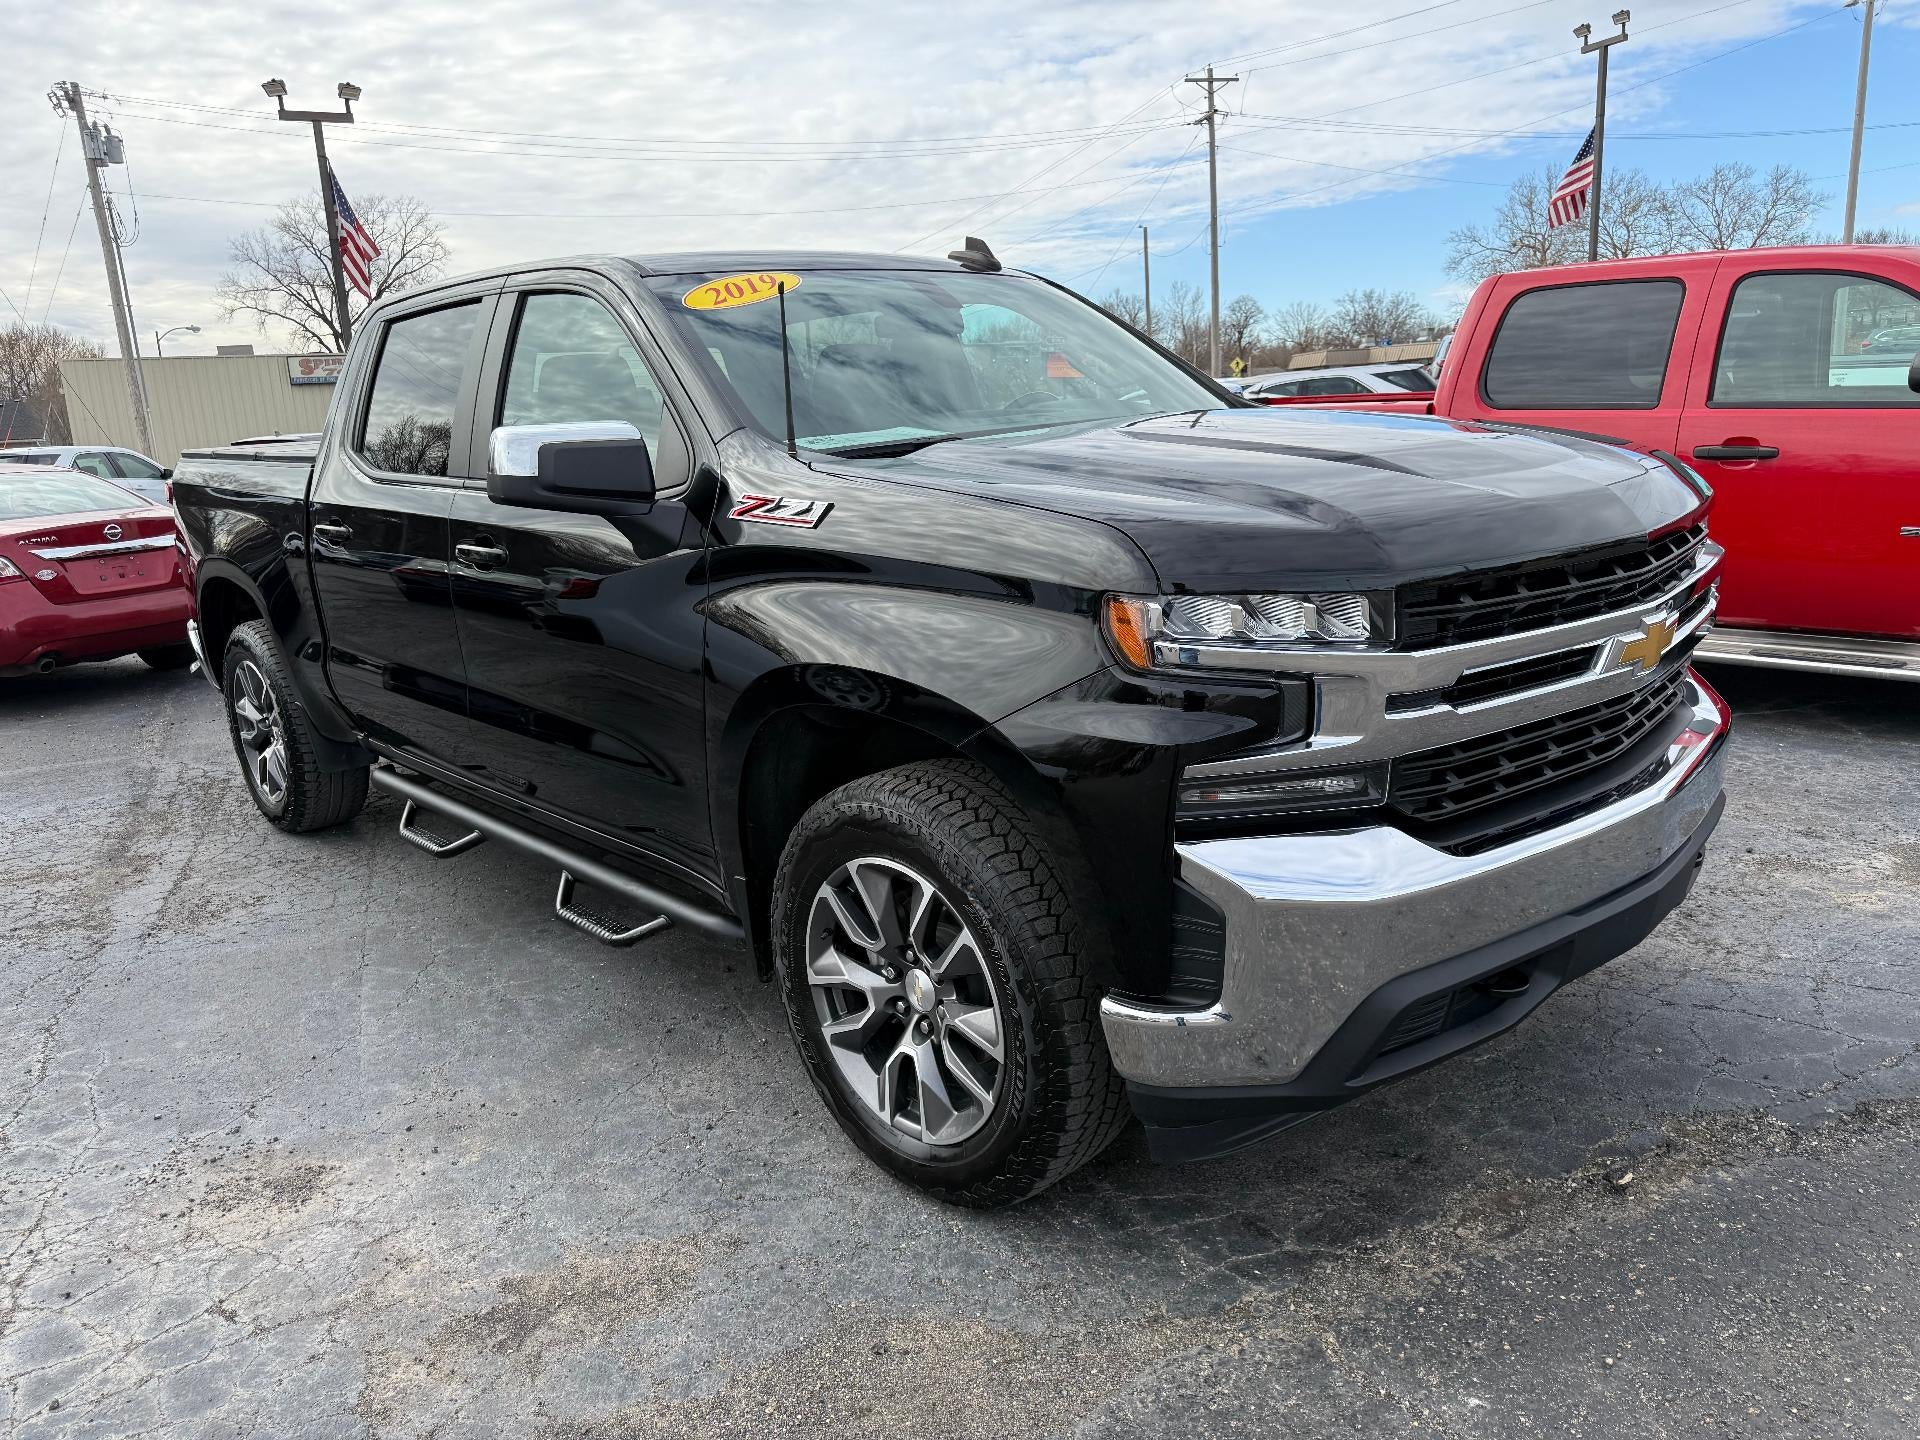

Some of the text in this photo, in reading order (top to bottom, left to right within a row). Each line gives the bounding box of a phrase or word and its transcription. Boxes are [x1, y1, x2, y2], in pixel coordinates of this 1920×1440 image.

[704, 274, 777, 307] 2019
[727, 492, 835, 530] Z71
[18, 535, 59, 547] ALTIMA
